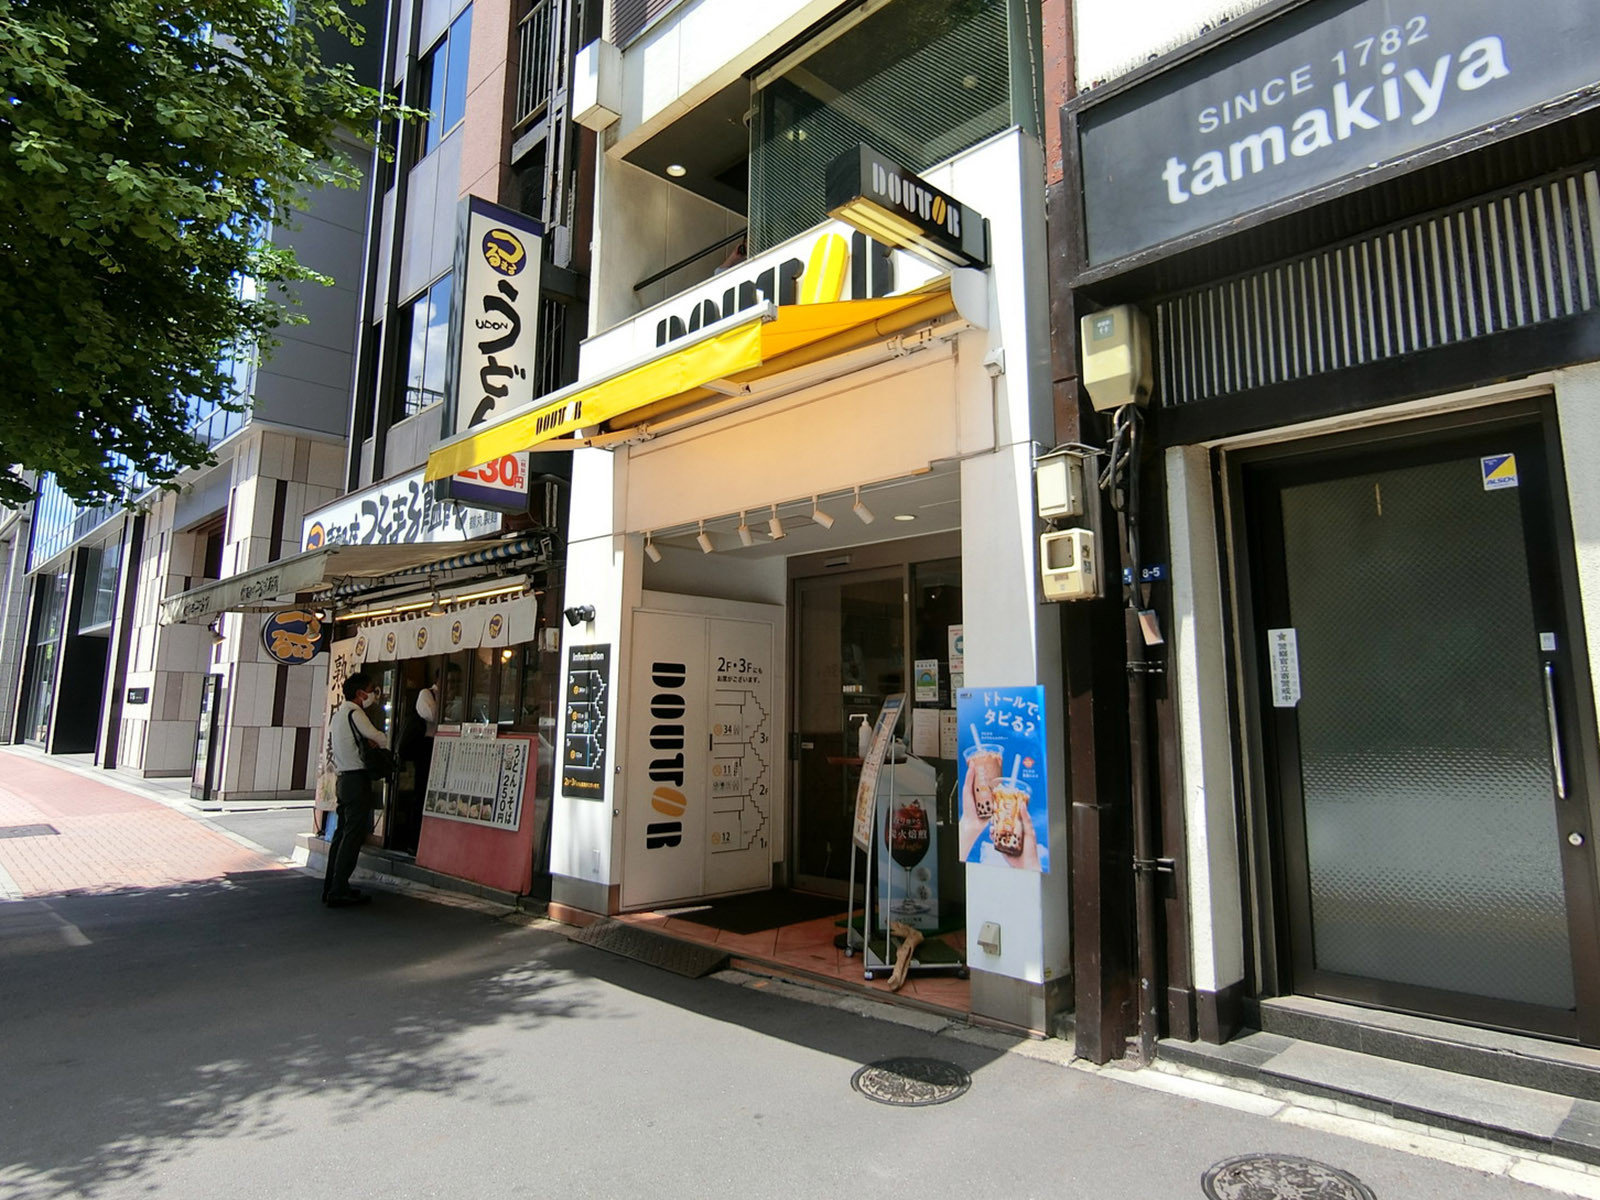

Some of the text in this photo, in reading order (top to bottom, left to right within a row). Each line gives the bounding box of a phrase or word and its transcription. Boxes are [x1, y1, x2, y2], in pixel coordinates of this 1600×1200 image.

[1198, 15, 1429, 134] SINCE 1782
[1162, 35, 1511, 204] tamakiya
[872, 162, 960, 238] DOUTOR
[475, 319, 509, 330] UDON
[1142, 567, 1160, 578] 8-5
[572, 651, 605, 661] Information
[647, 662, 687, 849] DOUTOR
